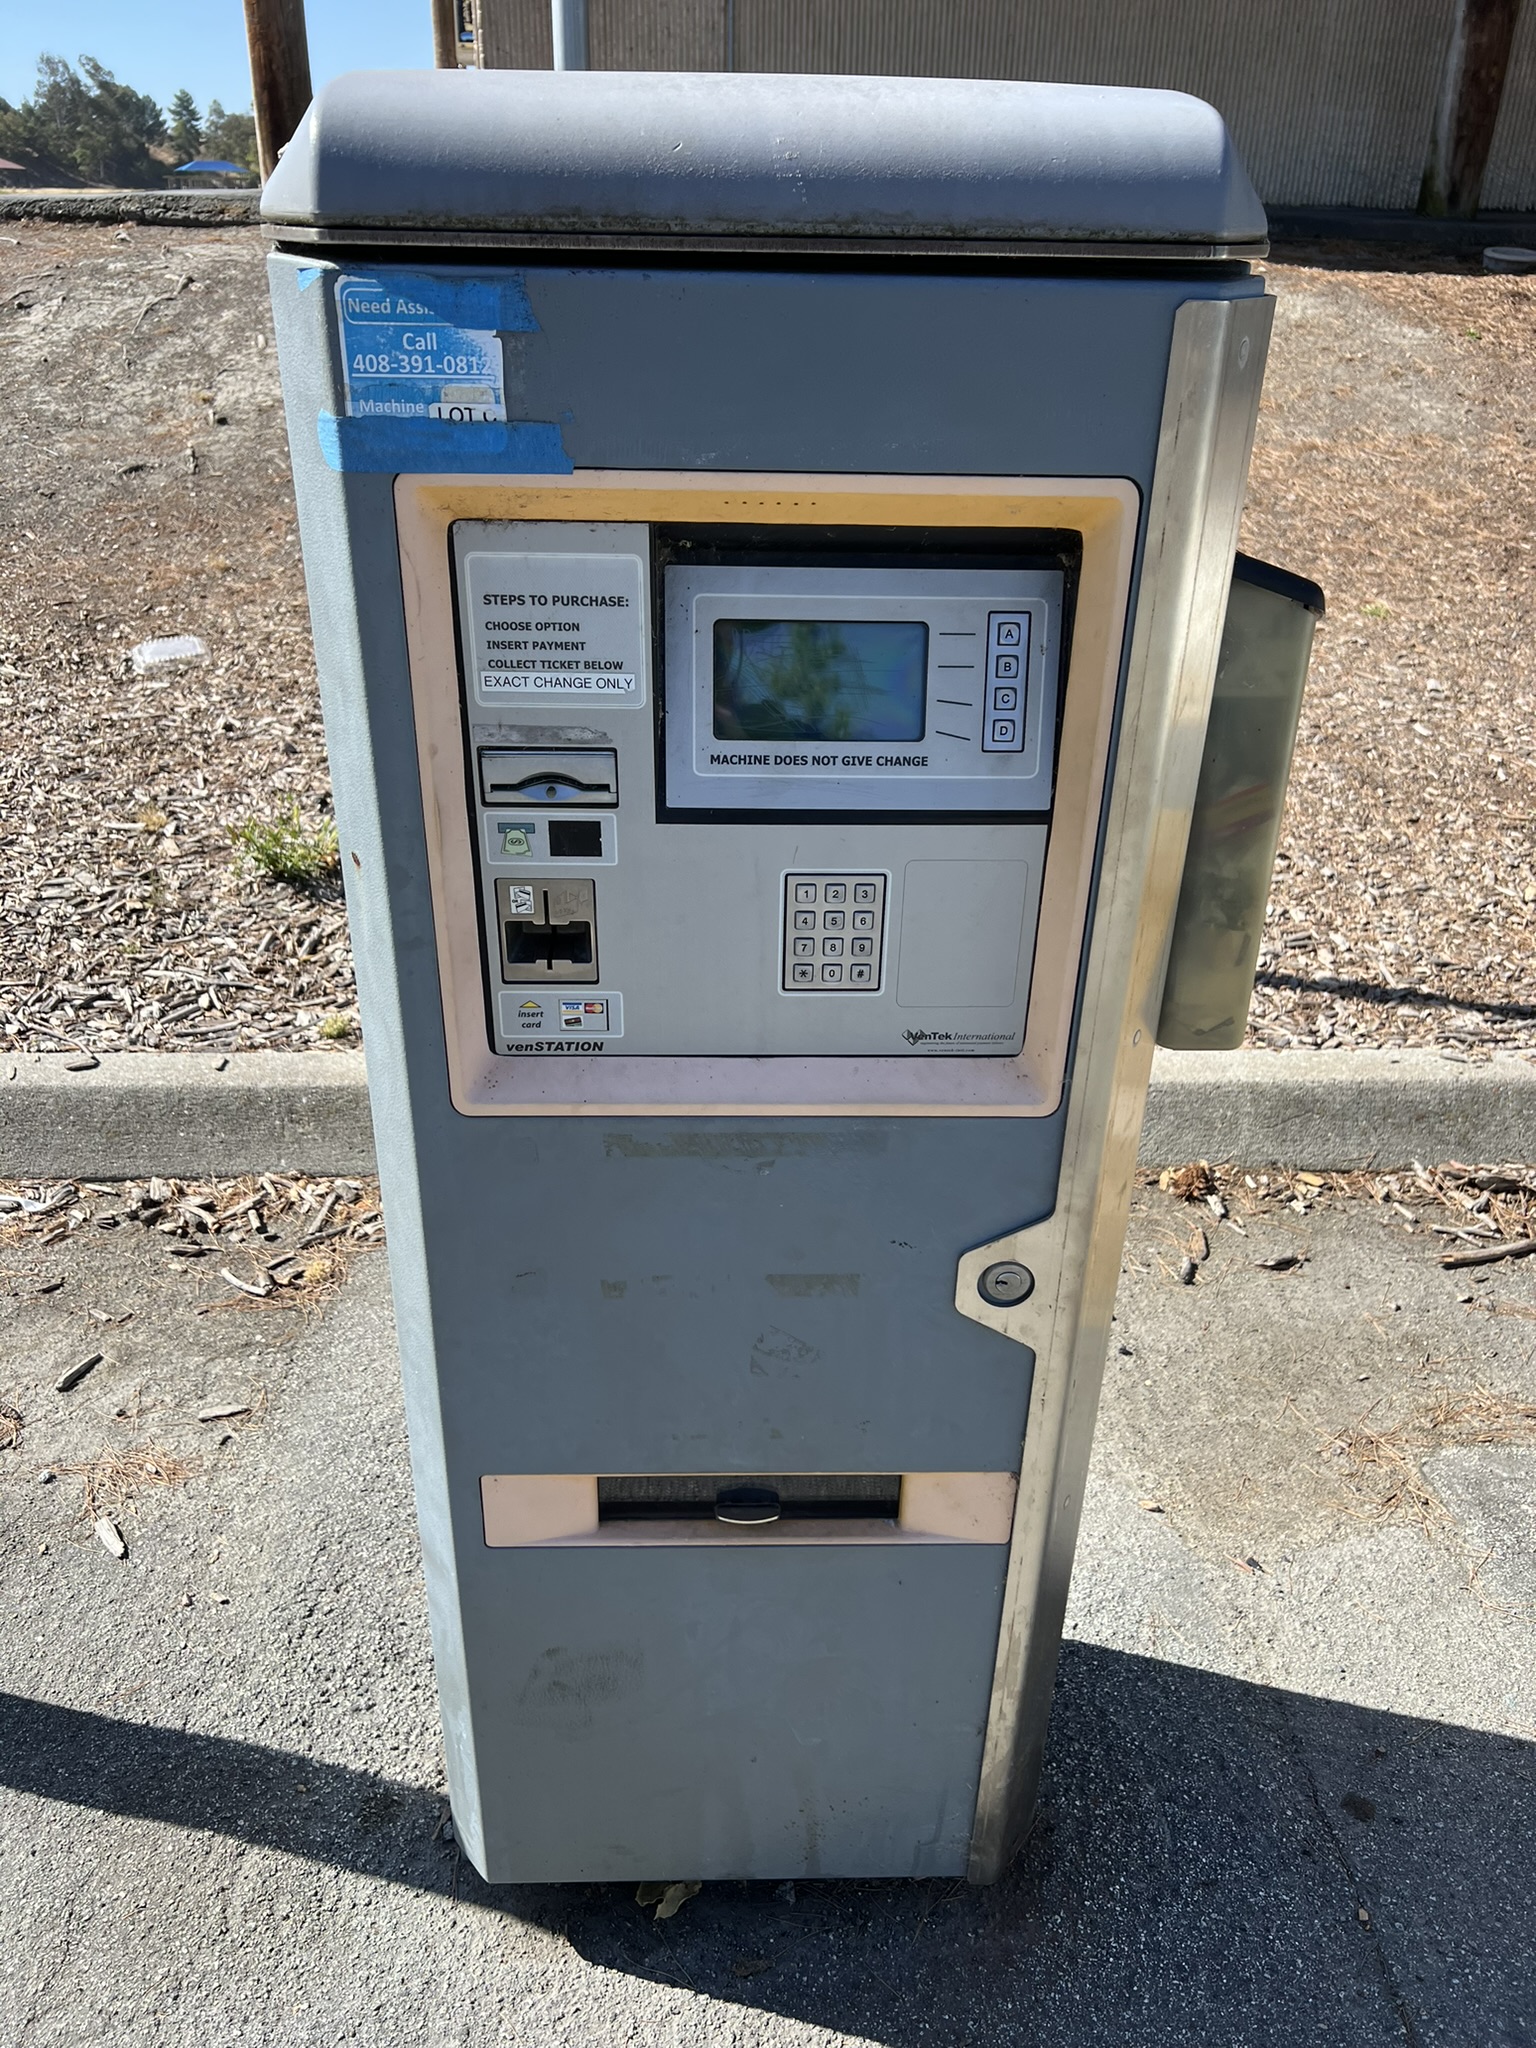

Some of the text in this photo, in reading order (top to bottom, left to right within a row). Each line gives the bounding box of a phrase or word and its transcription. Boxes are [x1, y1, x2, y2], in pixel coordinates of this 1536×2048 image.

[347, 298, 391, 314] Need
[402, 332, 438, 351] Call
[352, 354, 492, 374] 408-391-0812
[359, 398, 424, 414] Machine
[482, 594, 630, 608] STEPS TO PURCHASE:
[485, 621, 580, 632] CHOOSE OPTION
[1004, 628, 1014, 640] A
[486, 640, 586, 651] INSERT PAYMENT
[488, 659, 624, 670] COLLECT TICKET BELOW
[1003, 661, 1012, 672] B
[484, 676, 633, 690] EXACT CHANGE ONLY
[1001, 693, 1010, 704] C
[998, 726, 1008, 736] D
[709, 754, 929, 767] MACHINE DOES NOT GIVE CHANGE
[804, 890, 809, 898] 1
[832, 890, 839, 899] 2
[861, 890, 868, 899] 3
[802, 917, 808, 925] 4
[831, 917, 837, 925] 5
[860, 917, 866, 925] 6
[801, 944, 807, 952] 7
[830, 944, 836, 952] 8
[858, 944, 865, 952] 9
[829, 970, 835, 978] 0
[518, 1010, 544, 1018] insert
[953, 1032, 1016, 1041] International
[506, 1042, 604, 1052] venSTATION
